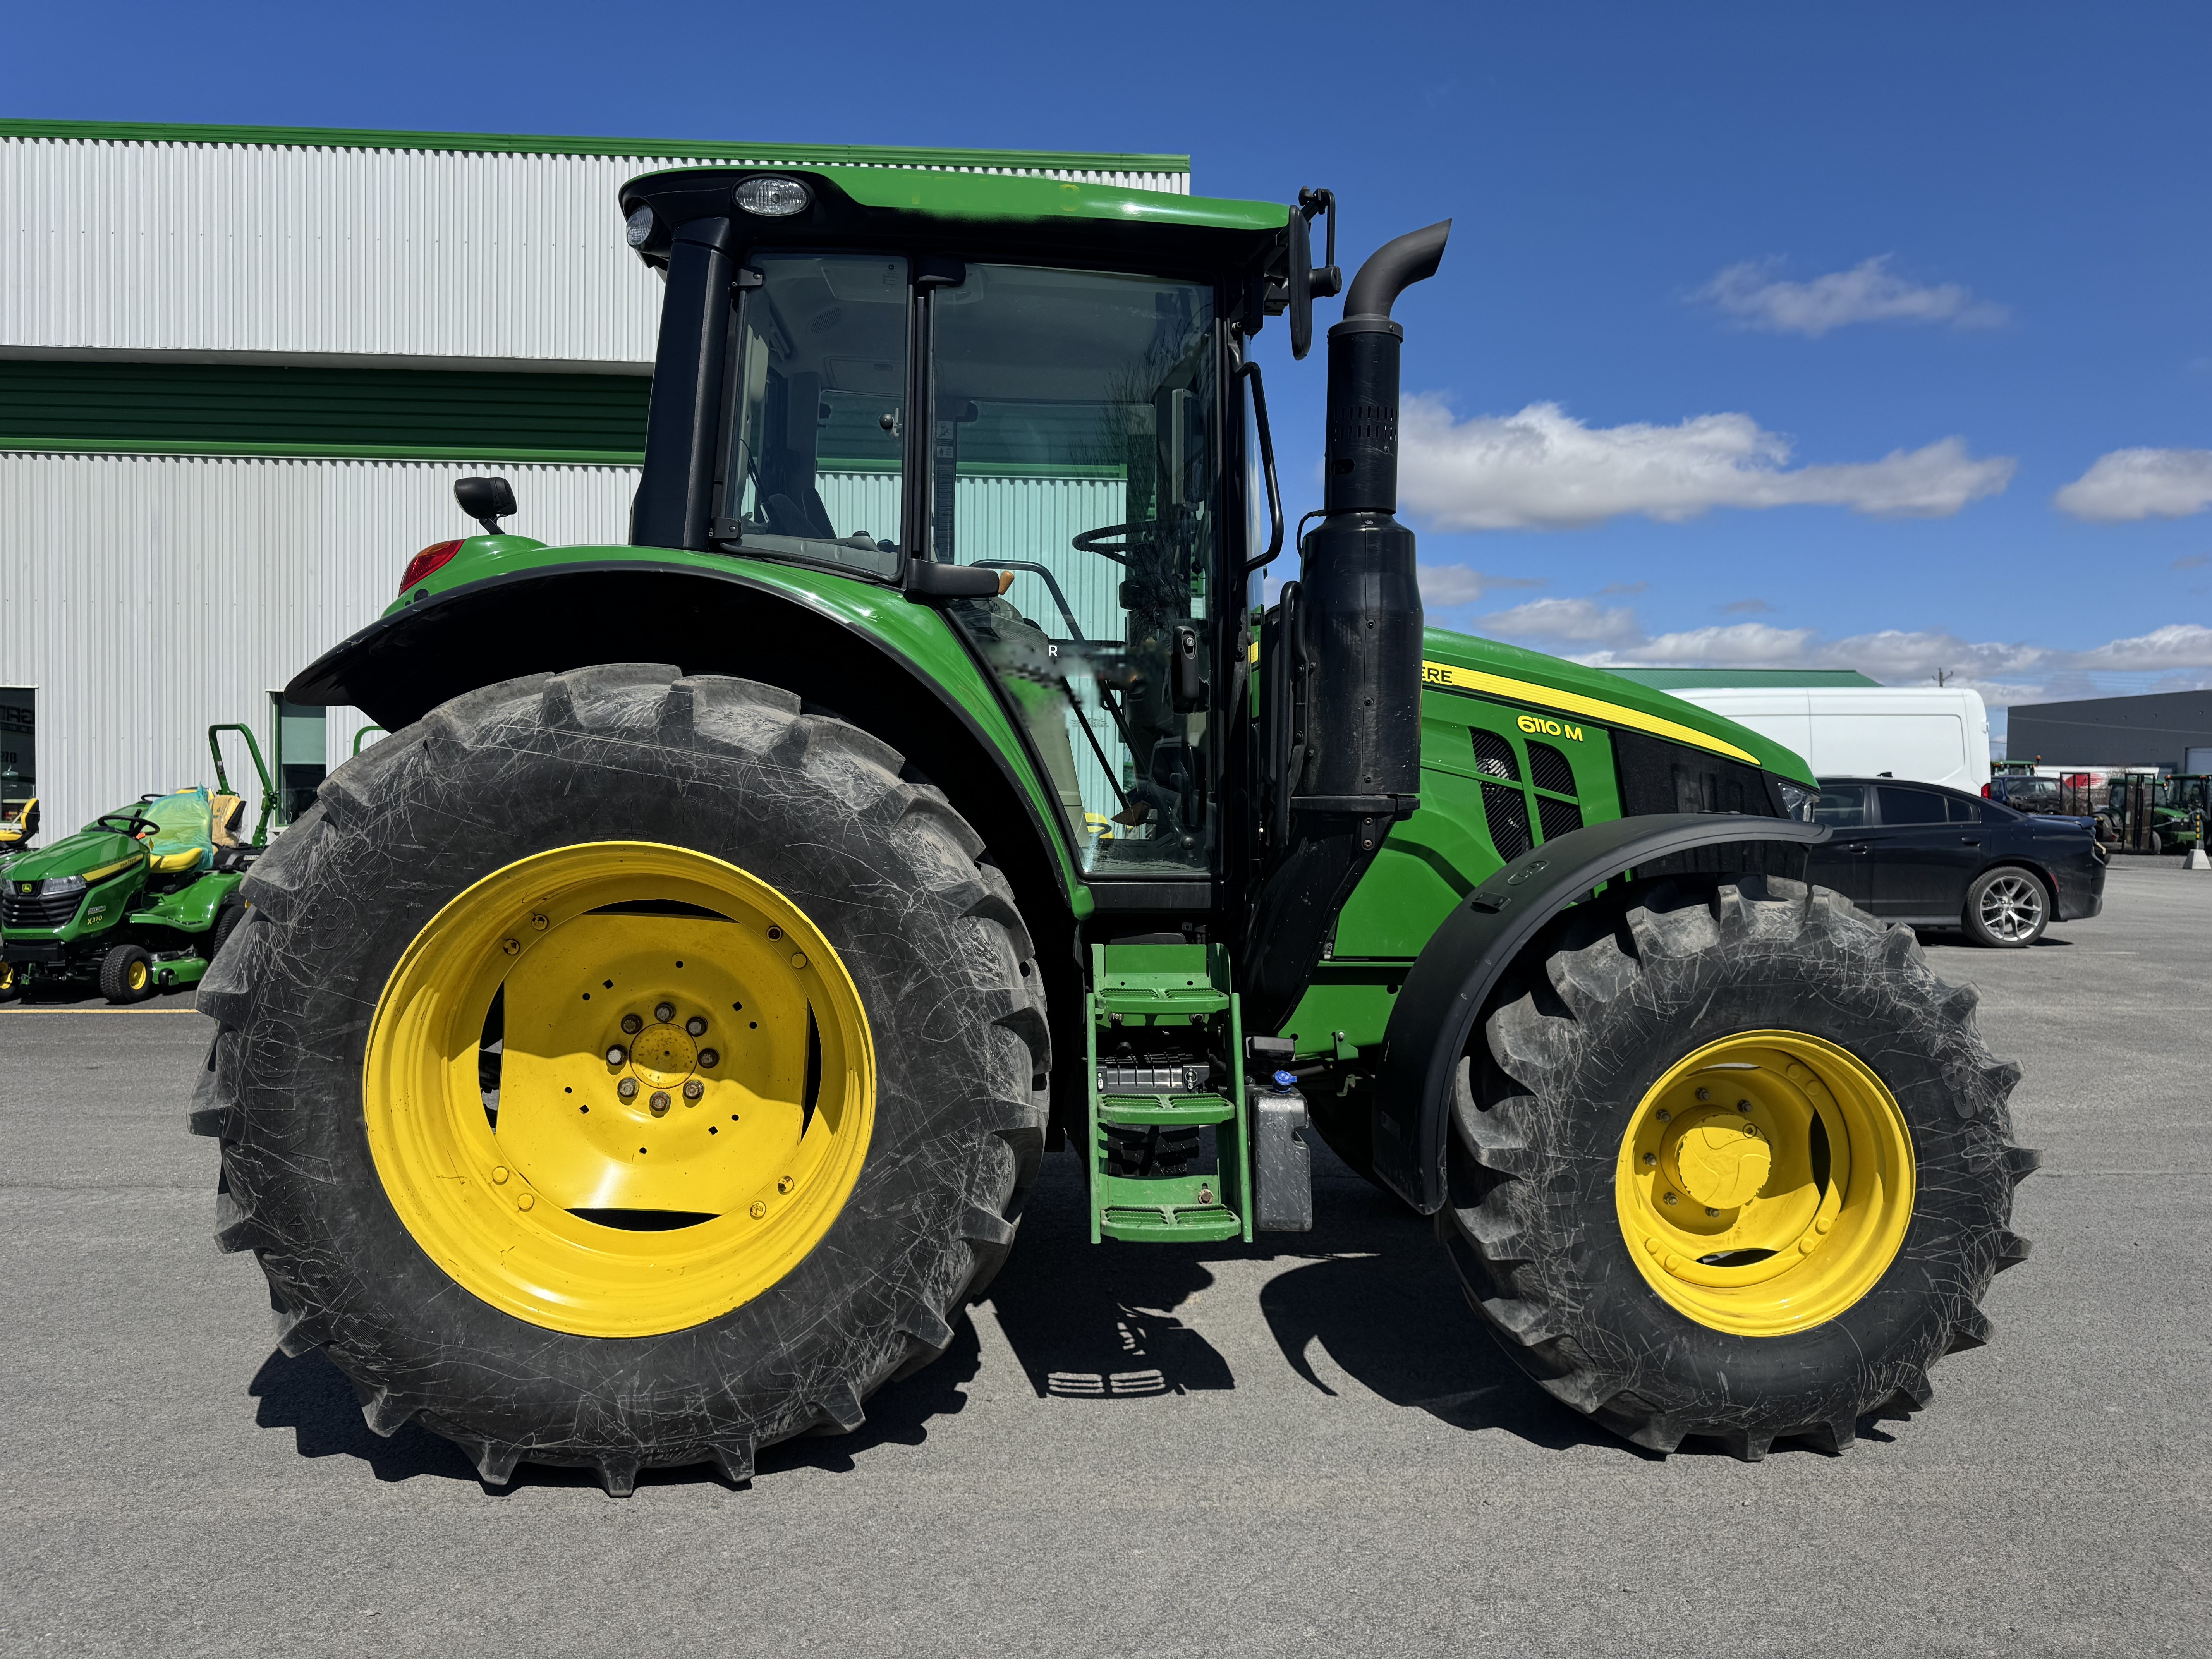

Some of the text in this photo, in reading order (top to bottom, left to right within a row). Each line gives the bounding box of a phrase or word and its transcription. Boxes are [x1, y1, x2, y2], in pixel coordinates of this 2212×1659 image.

[1517, 715, 1583, 742] 6110 M
[292, 833, 394, 950] 85
[87, 915, 102, 925] X370
[1939, 1056, 1986, 1119] 85
